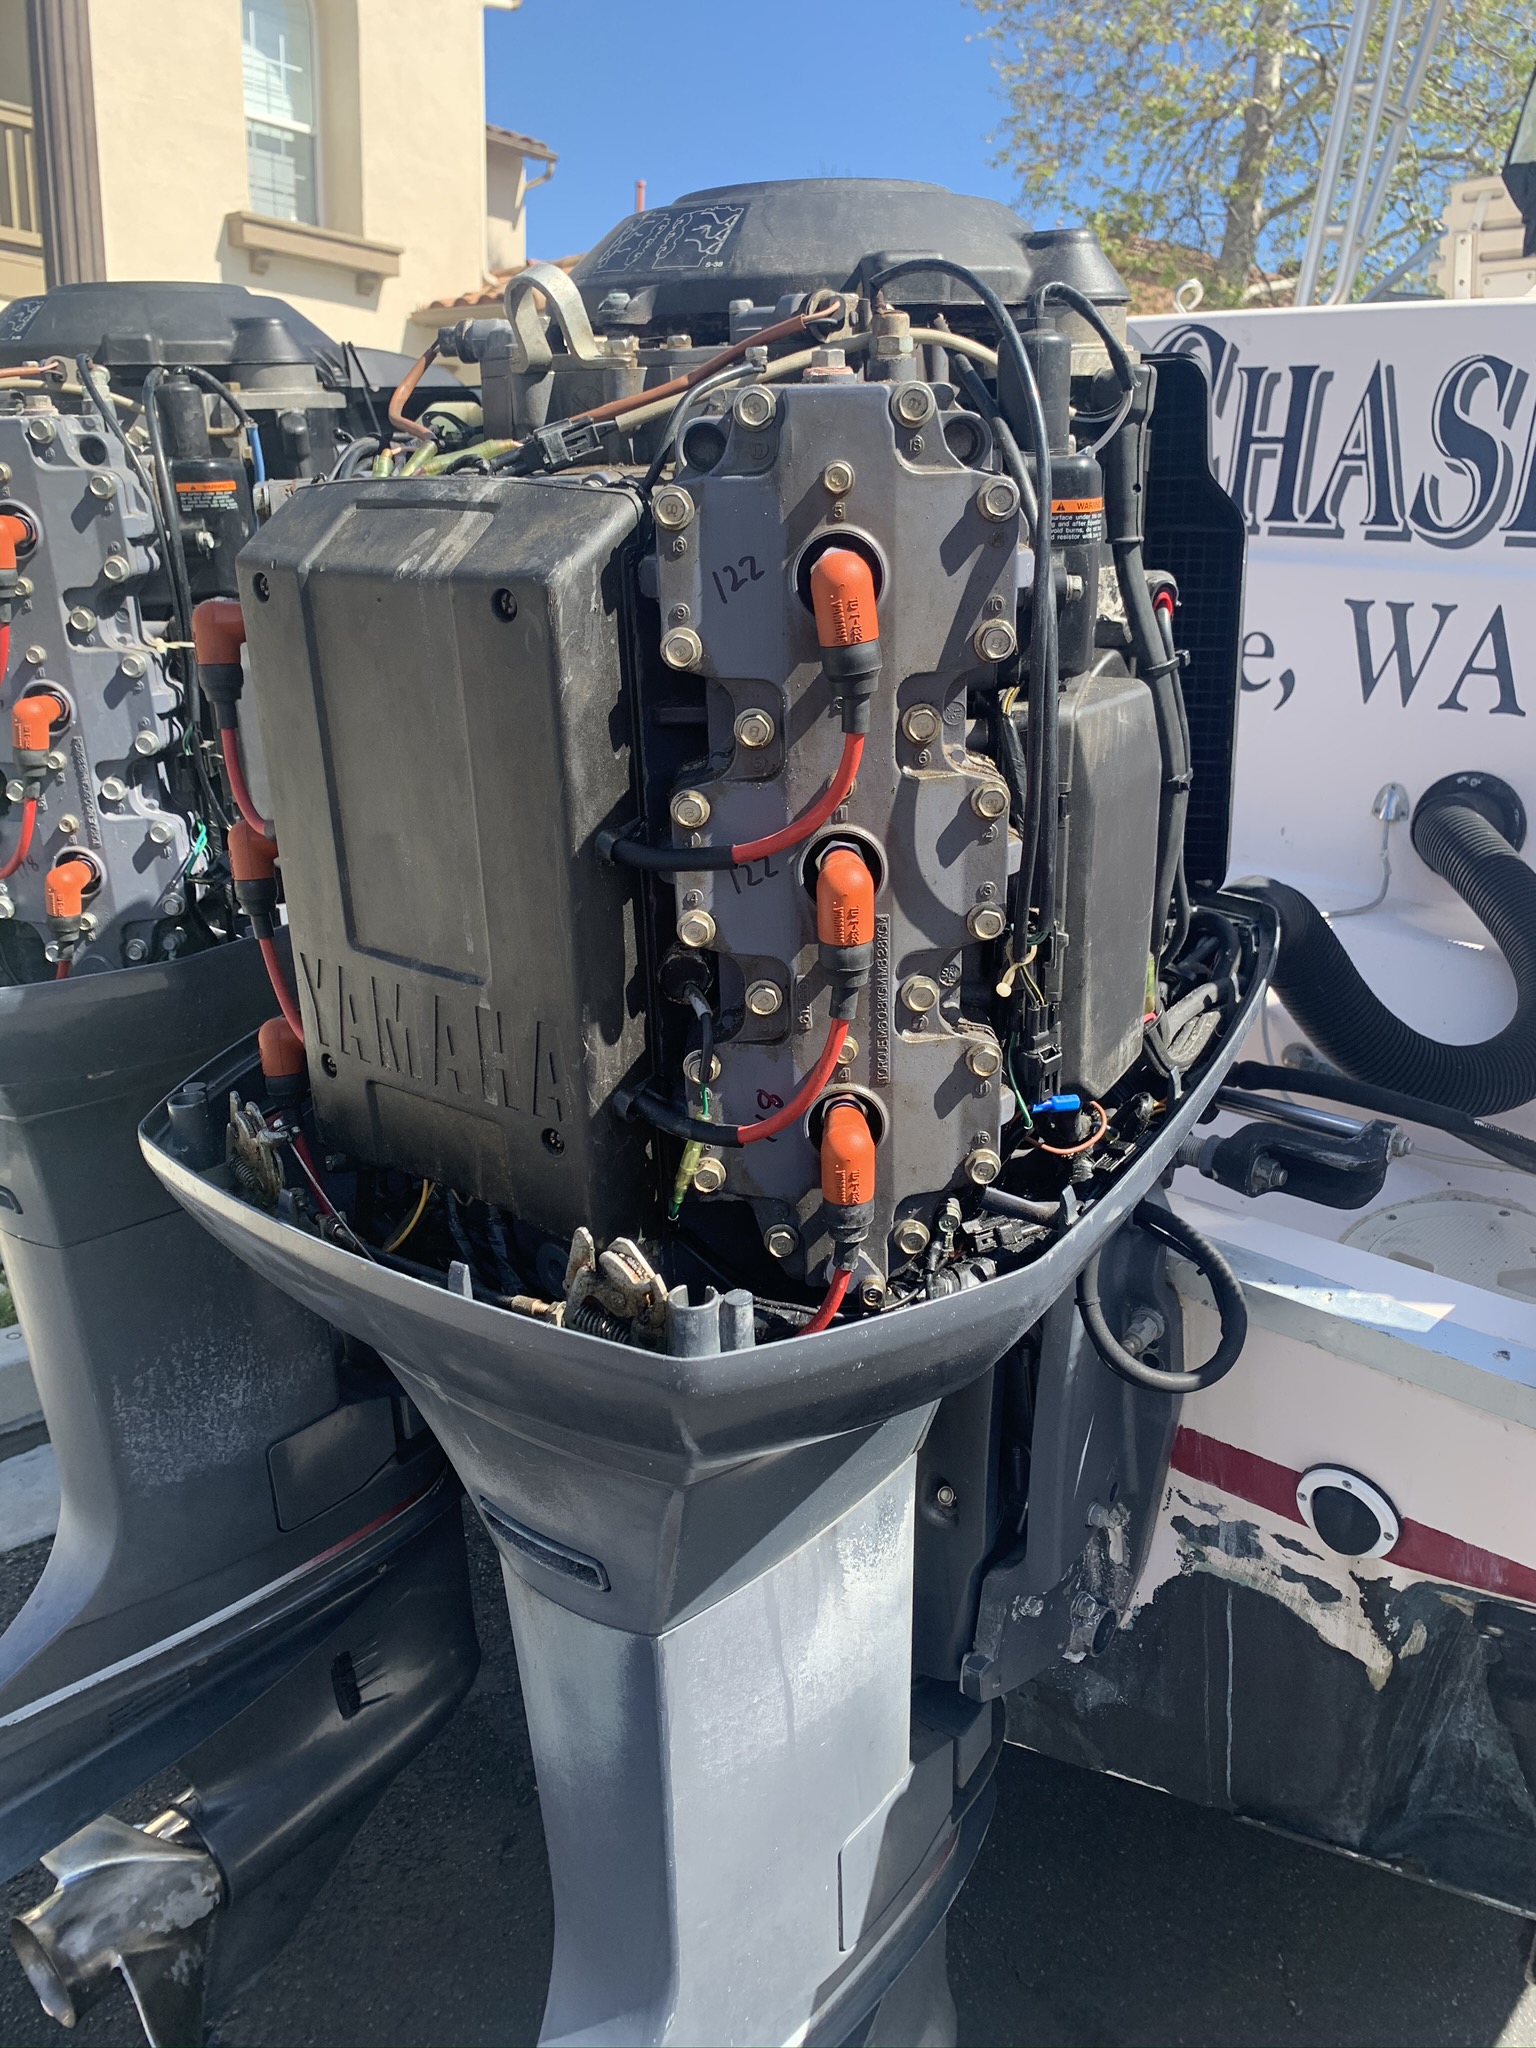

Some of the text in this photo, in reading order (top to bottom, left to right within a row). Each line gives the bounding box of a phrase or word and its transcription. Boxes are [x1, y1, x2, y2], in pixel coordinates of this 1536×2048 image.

[1152, 323, 1536, 549] HAS
[834, 504, 844, 518] 5
[712, 555, 766, 604] 122
[1344, 598, 1526, 717] WA
[730, 855, 779, 894] 122
[299, 952, 572, 1122] YAMAHA
